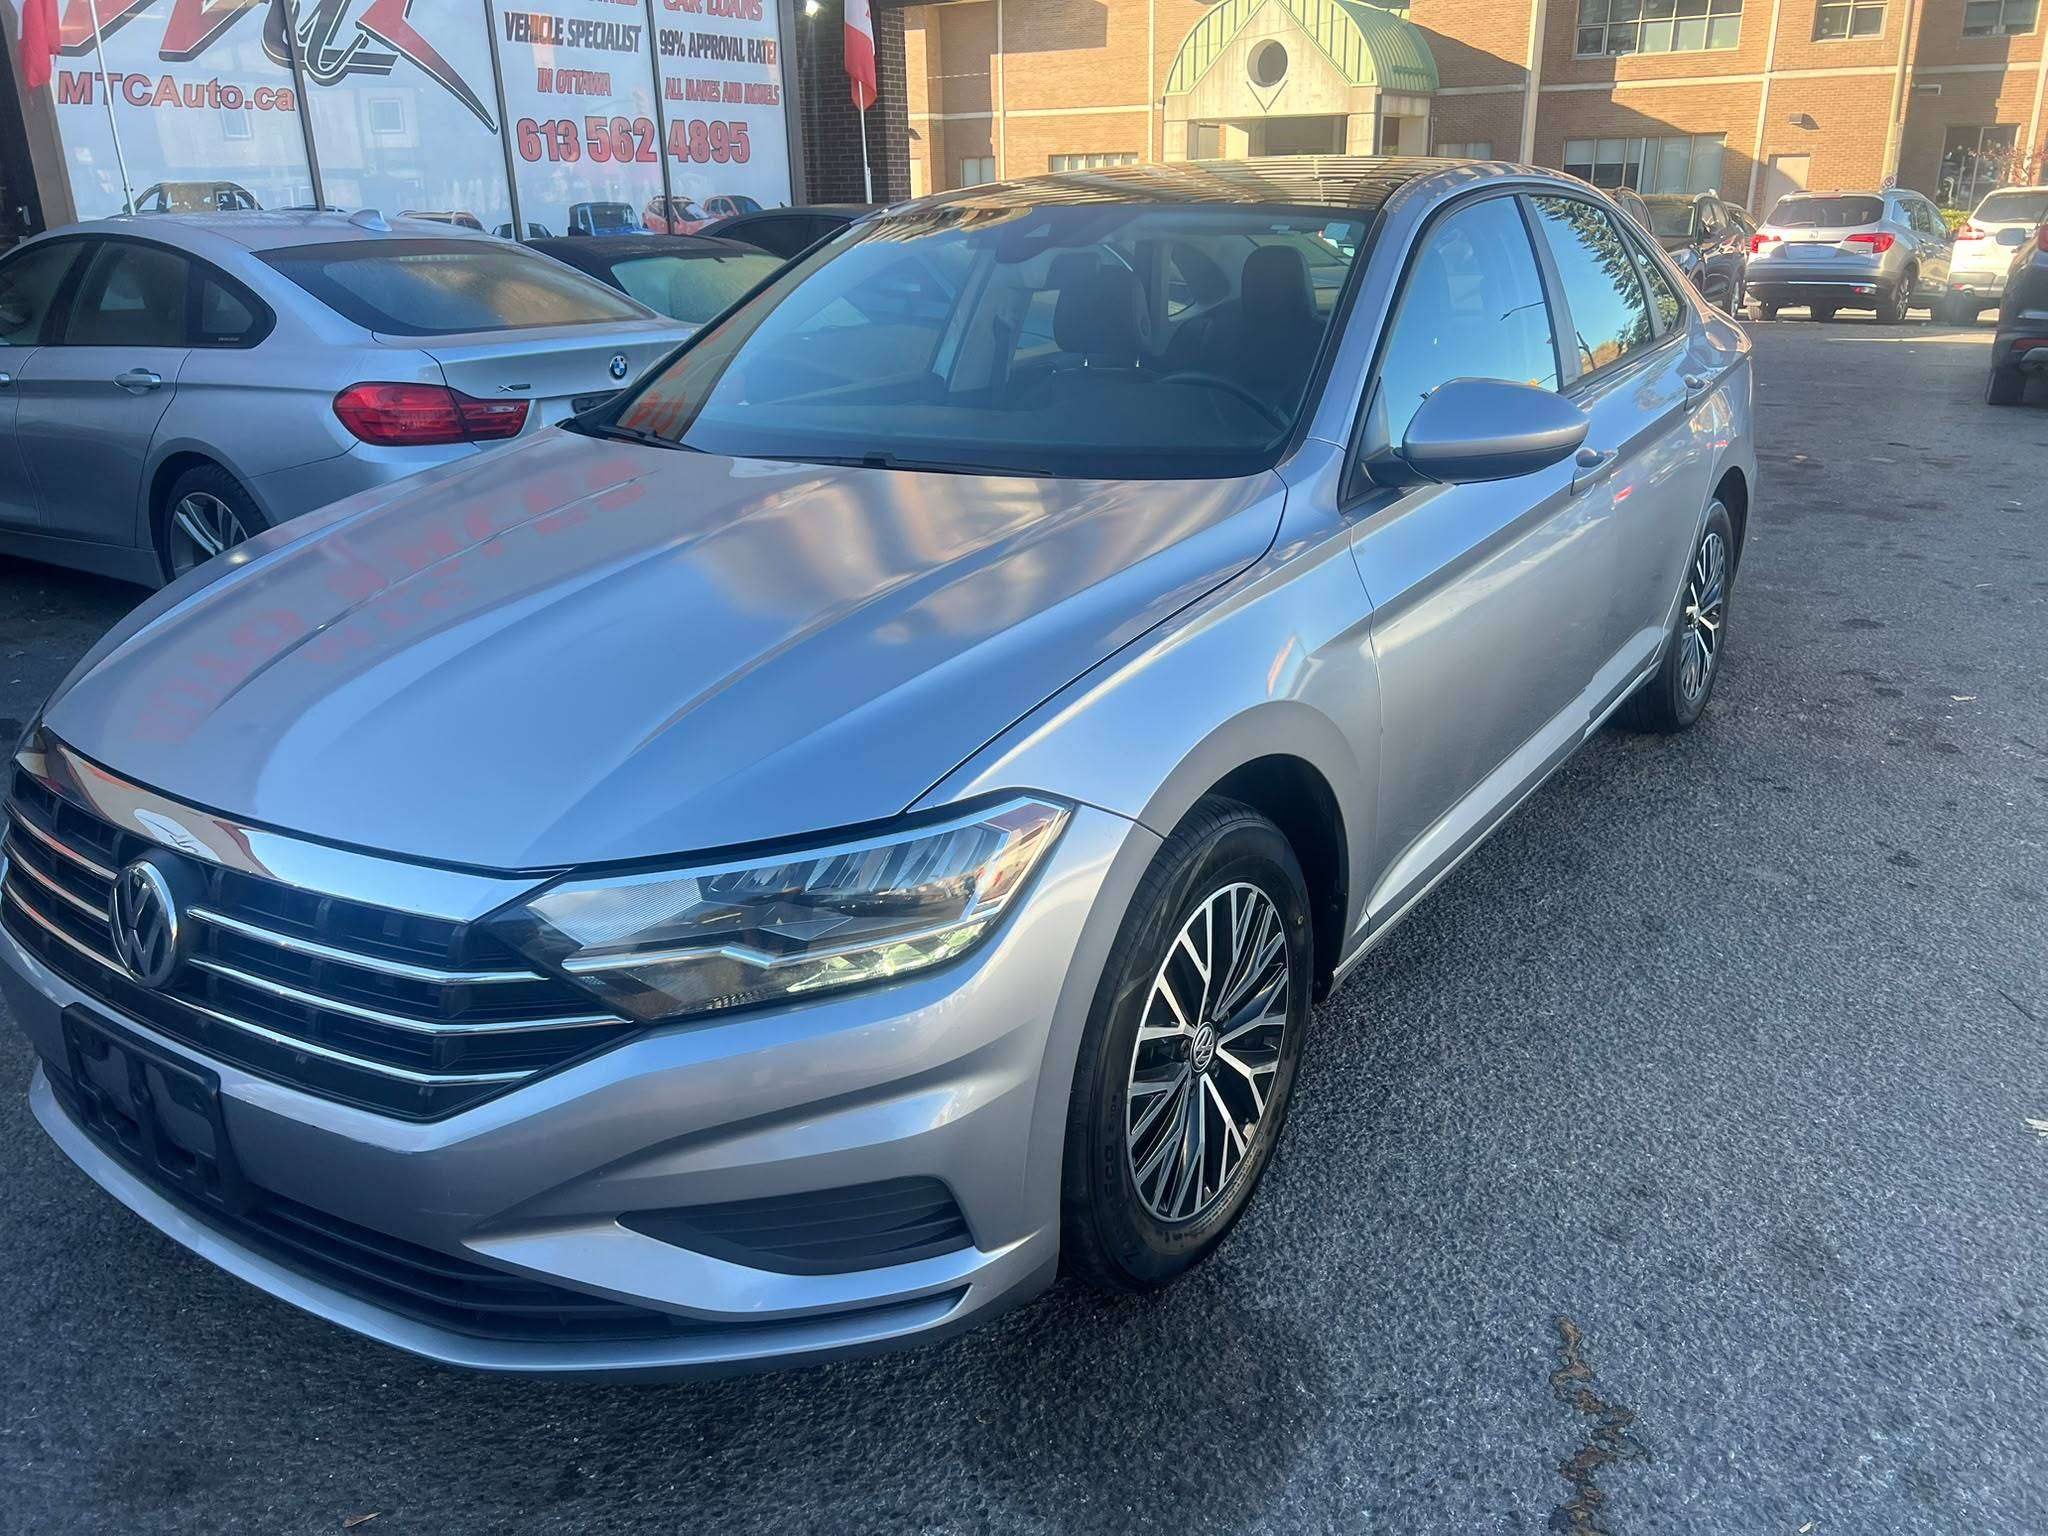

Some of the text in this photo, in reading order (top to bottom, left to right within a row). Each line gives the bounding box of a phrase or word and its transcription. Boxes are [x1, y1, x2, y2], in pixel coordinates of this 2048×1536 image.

[504, 11, 642, 53] VEHICLE SPECIALIST
[660, 28, 686, 57] 99%
[688, 32, 746, 63] APPROVAL
[57, 70, 296, 112] MTCAuto.ca
[537, 67, 613, 97] IN OTTAWA
[664, 76, 780, 106] ALL MAKES AND MODELS
[516, 116, 751, 164] 613 562 4895
